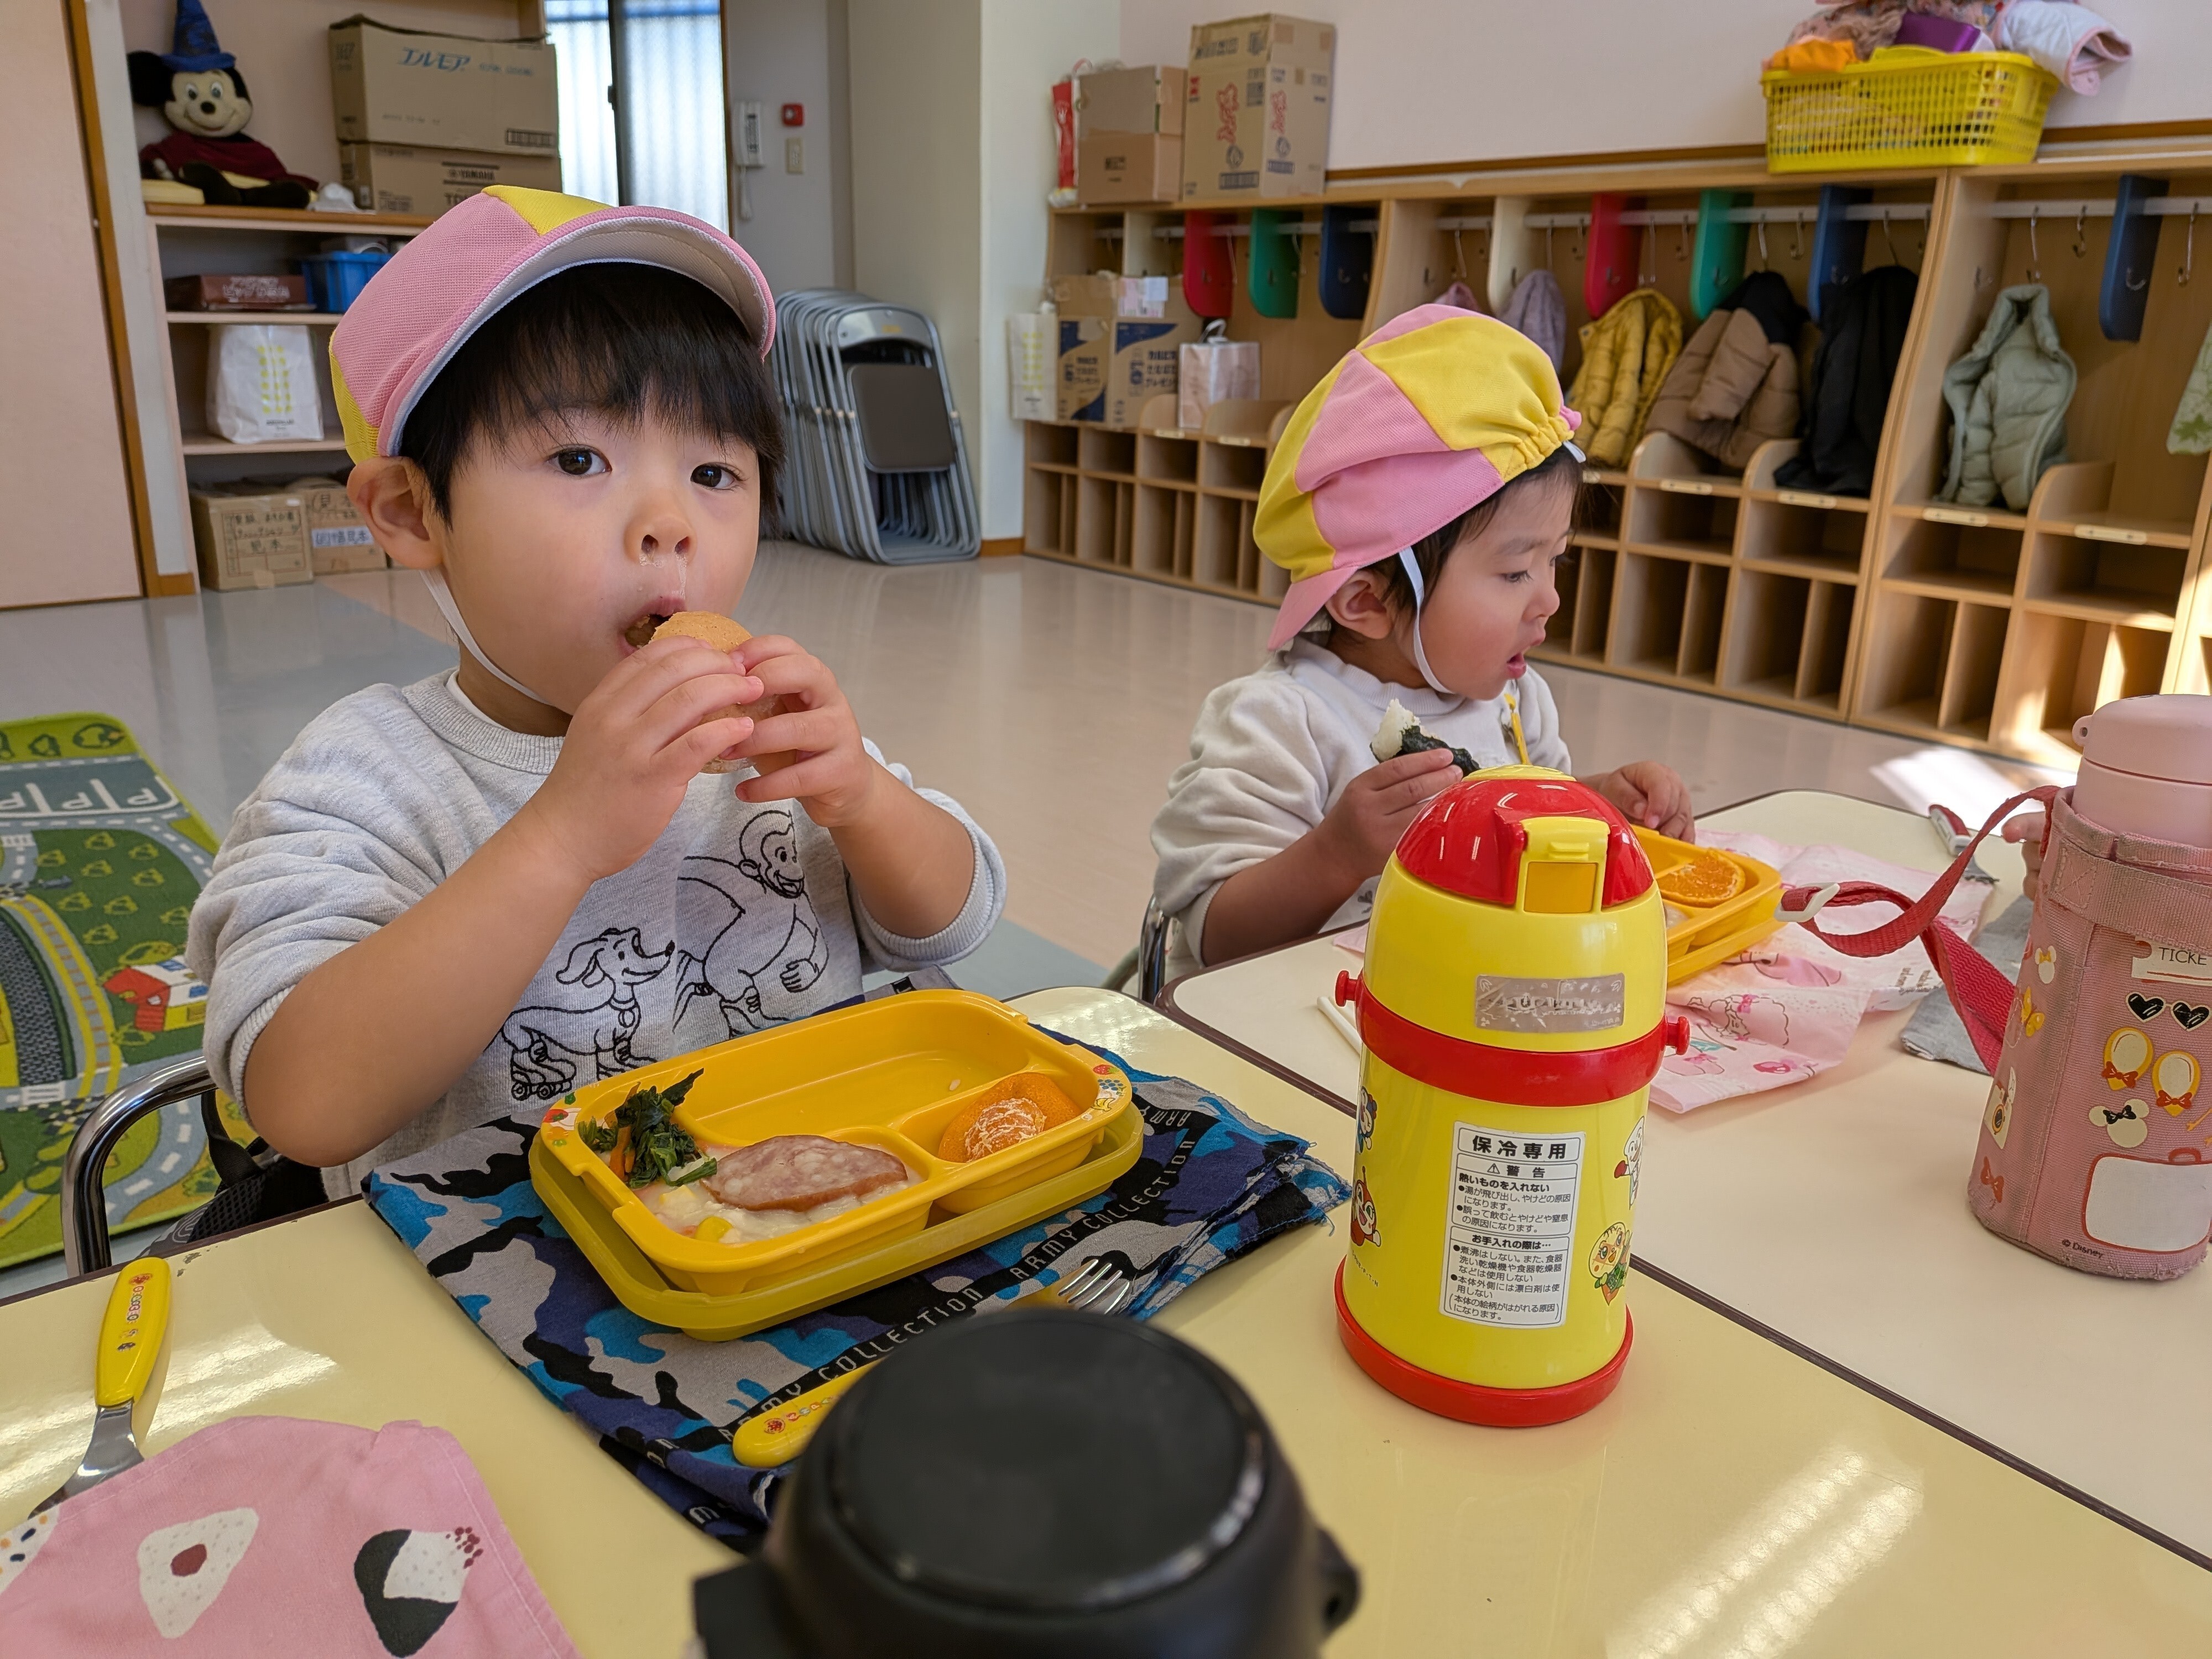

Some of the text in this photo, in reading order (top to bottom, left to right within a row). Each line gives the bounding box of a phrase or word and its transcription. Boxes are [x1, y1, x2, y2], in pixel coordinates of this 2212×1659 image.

[1472, 1135, 1566, 1160] 保冷専用
[1506, 1165, 1546, 1178] 警告
[1458, 1172, 1550, 1192] 熱いものを入れない
[1464, 1196, 1512, 1212] になります。
[1462, 1215, 1537, 1233] の原因になります。
[2073, 1242, 2103, 1259] Disney
[818, 1288, 983, 1381] COLLECTION
[1010, 1229, 1077, 1280] ARMY
[1083, 1140, 1195, 1229] COLLECTION
[1458, 1265, 1533, 1282] などは使用しない
[1456, 1284, 1493, 1298] 用しない
